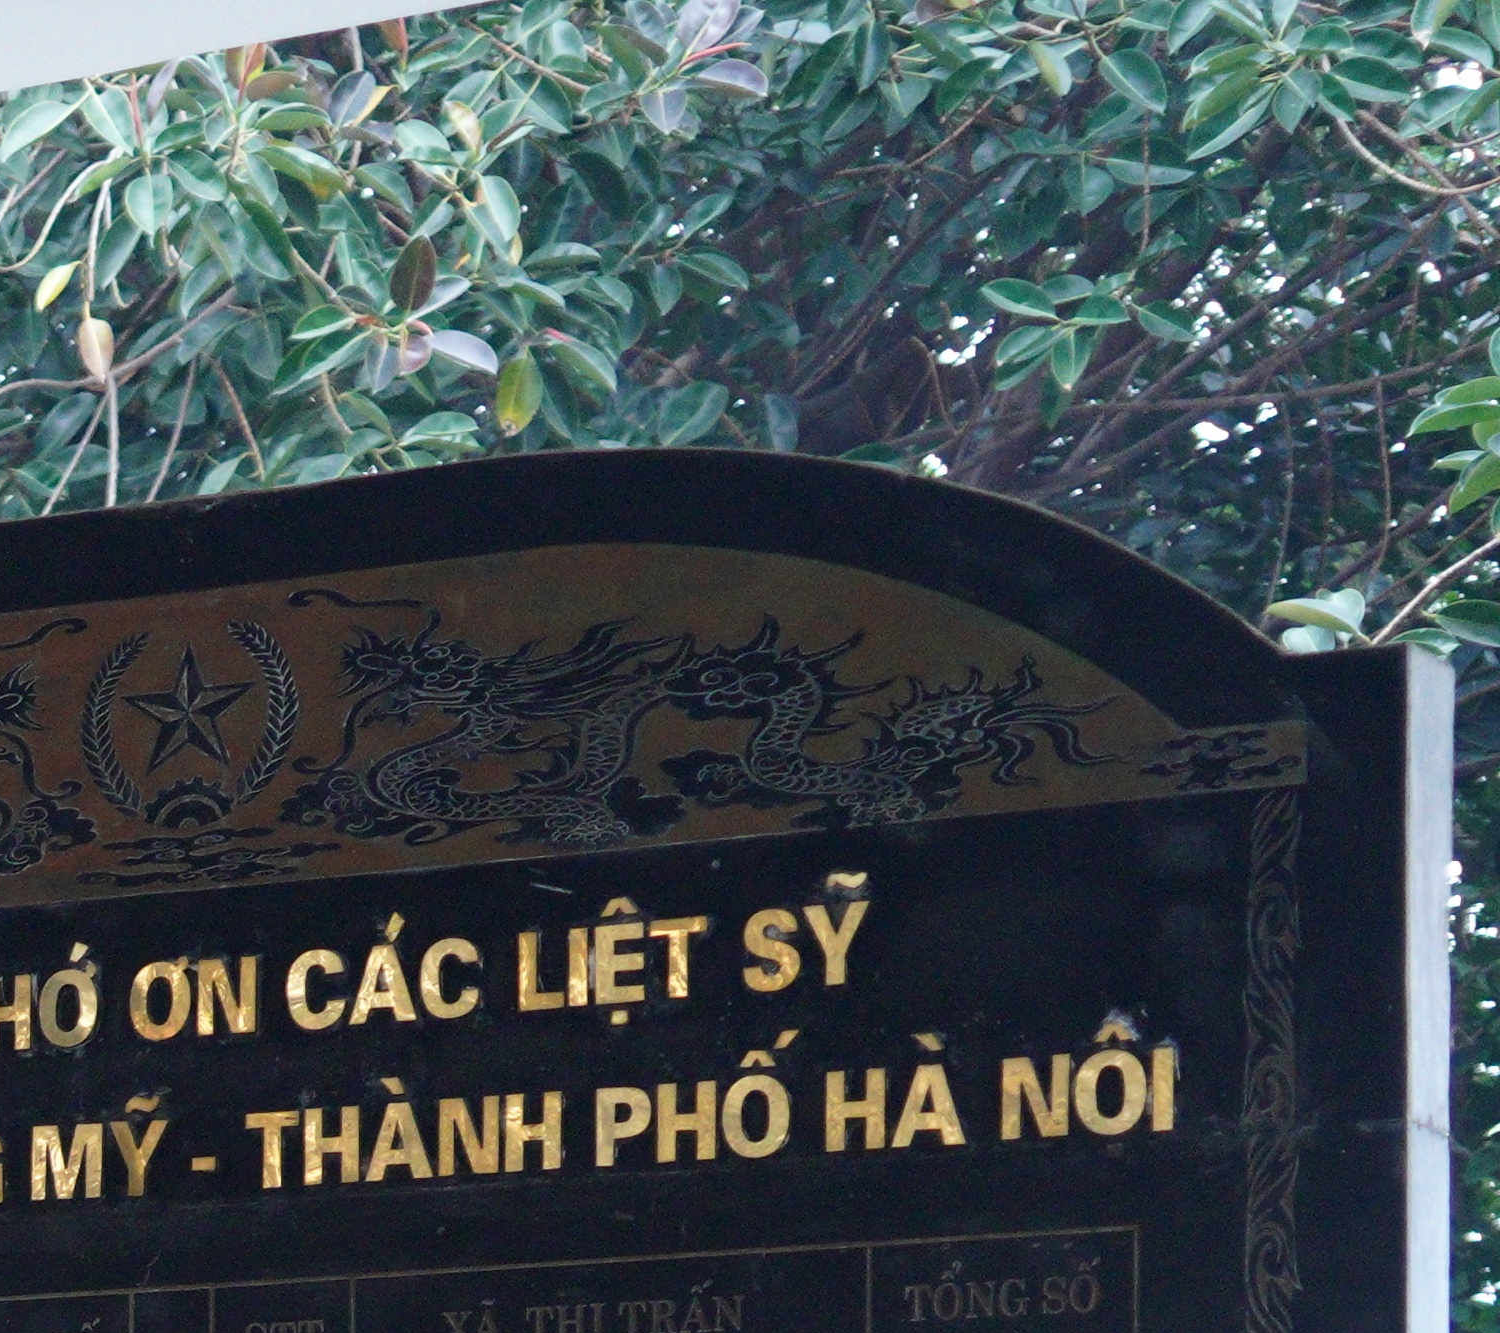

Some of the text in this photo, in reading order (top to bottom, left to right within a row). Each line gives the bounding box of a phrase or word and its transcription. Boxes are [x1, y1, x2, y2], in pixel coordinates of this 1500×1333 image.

[129, 955, 257, 1041] ƠN
[286, 912, 481, 1031] CÁC
[518, 896, 708, 1025] LIỆT
[742, 871, 869, 993] SỸ
[31, 1088, 171, 1201] MỸ
[191, 1156, 216, 1171] -
[245, 1077, 562, 1189] THÀNH
[595, 1029, 799, 1167] PHỐ
[825, 1032, 966, 1153] HÀ
[903, 1260, 1031, 1323] TỔNG
[1041, 1257, 1101, 1315] SỐ
